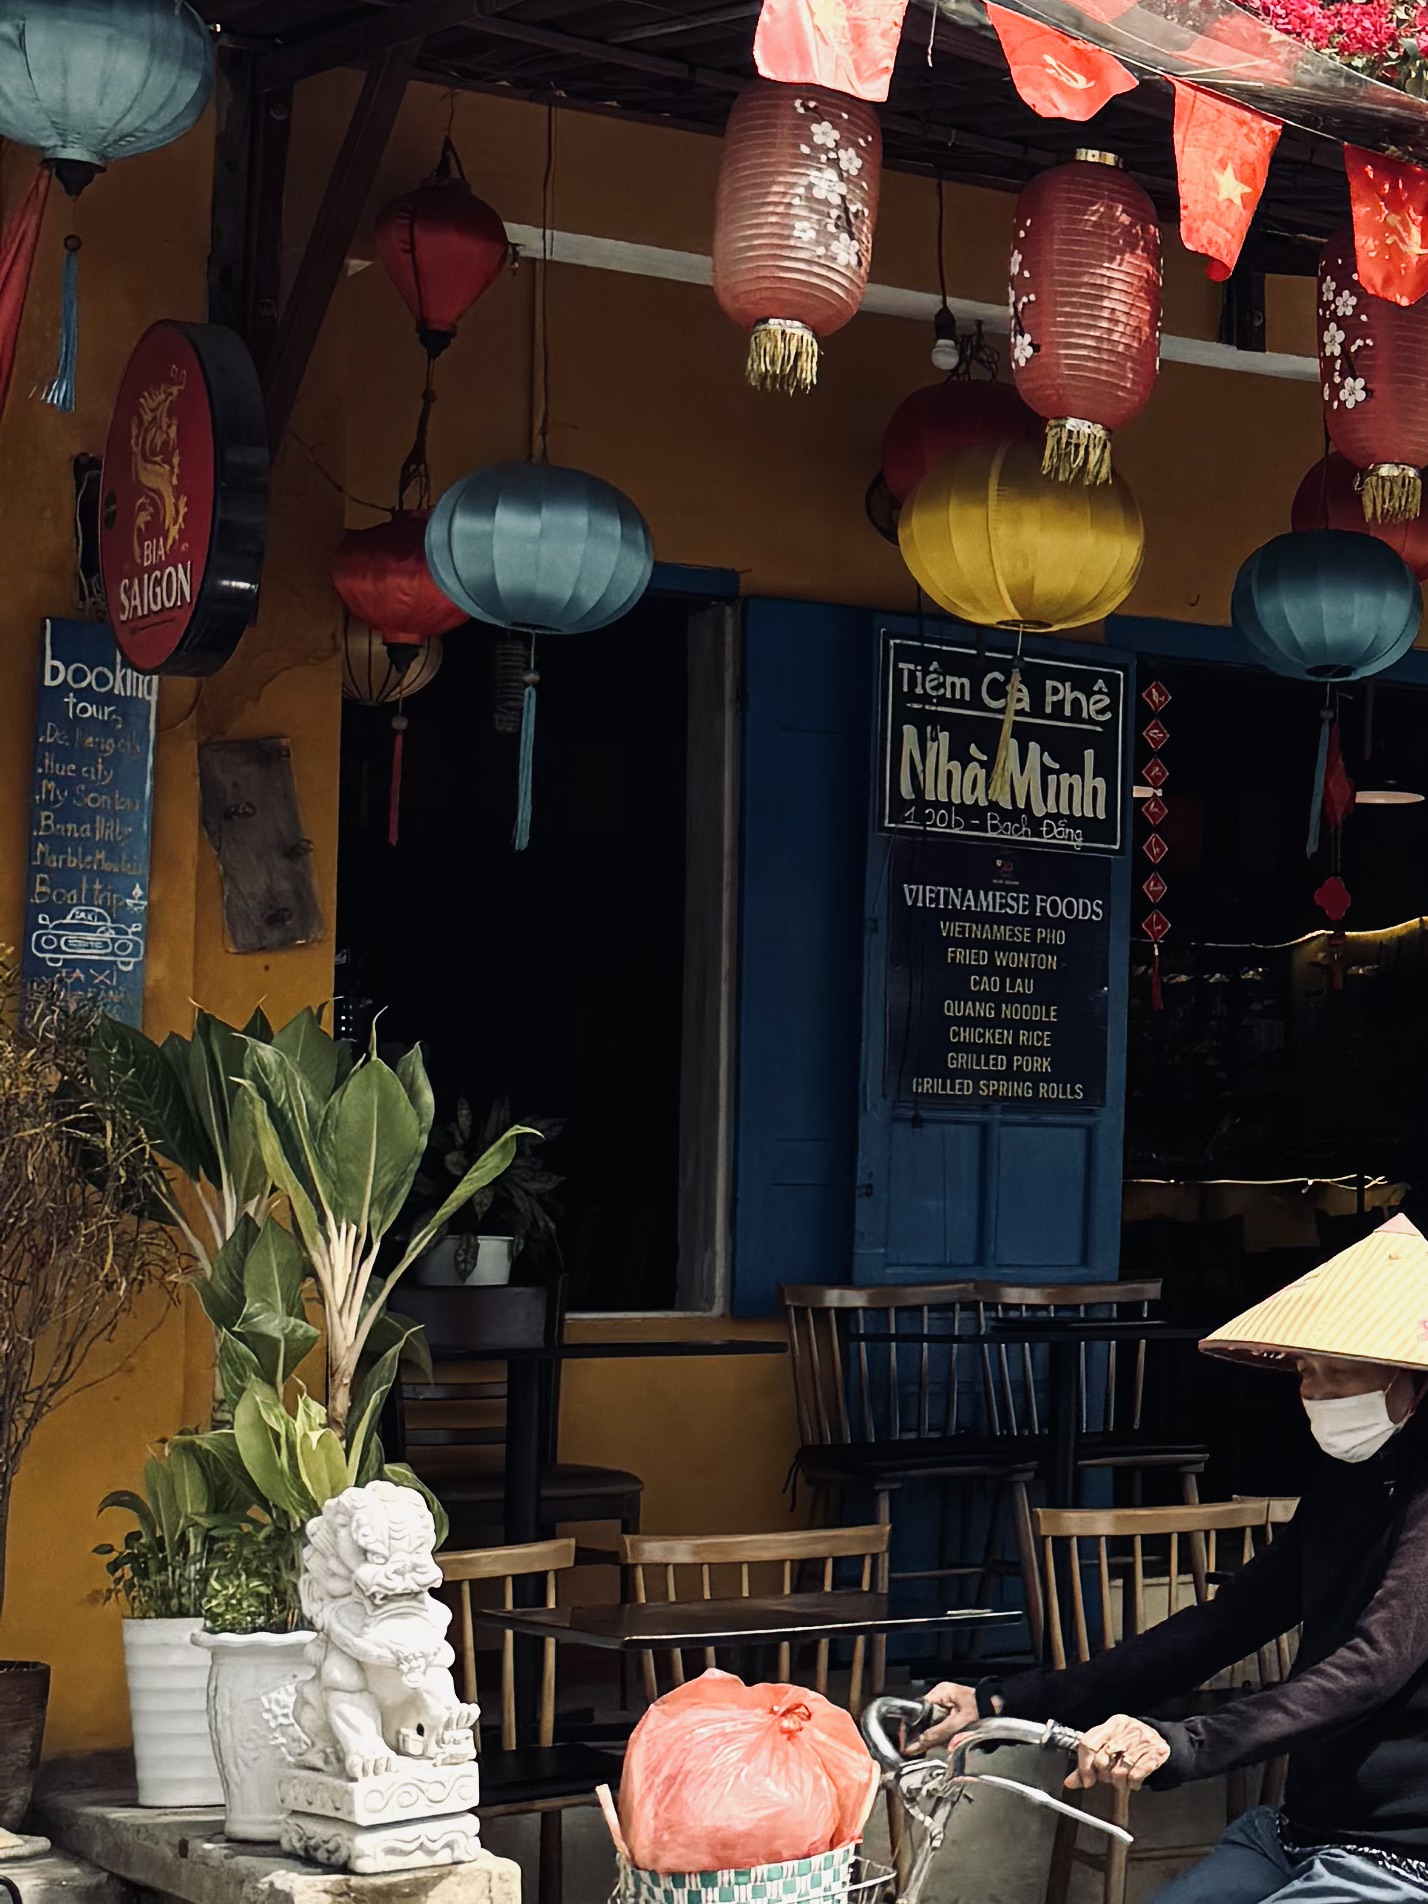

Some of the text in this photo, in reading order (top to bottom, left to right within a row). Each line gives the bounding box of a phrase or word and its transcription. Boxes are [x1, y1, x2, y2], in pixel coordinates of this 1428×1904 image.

[143, 539, 165, 566] BIA
[119, 560, 192, 622] SAIGON
[897, 660, 971, 704] Tiệm
[1045, 678, 1113, 722] Phê
[900, 723, 1107, 820] Nhà Mình
[903, 883, 1104, 922] VIETNAMESE FOODS
[940, 920, 1067, 946] VIETNAMESE PHO
[947, 946, 1058, 971] FRIED WONTON
[969, 975, 1035, 994] CAO LAU
[943, 999, 1059, 1022] QUANG NOODLE
[949, 1025, 1052, 1047] CHICKEN RICE
[947, 1051, 1052, 1073] GRILLED PORK
[912, 1076, 1085, 1100] GRILLED SPRING ROLLS
